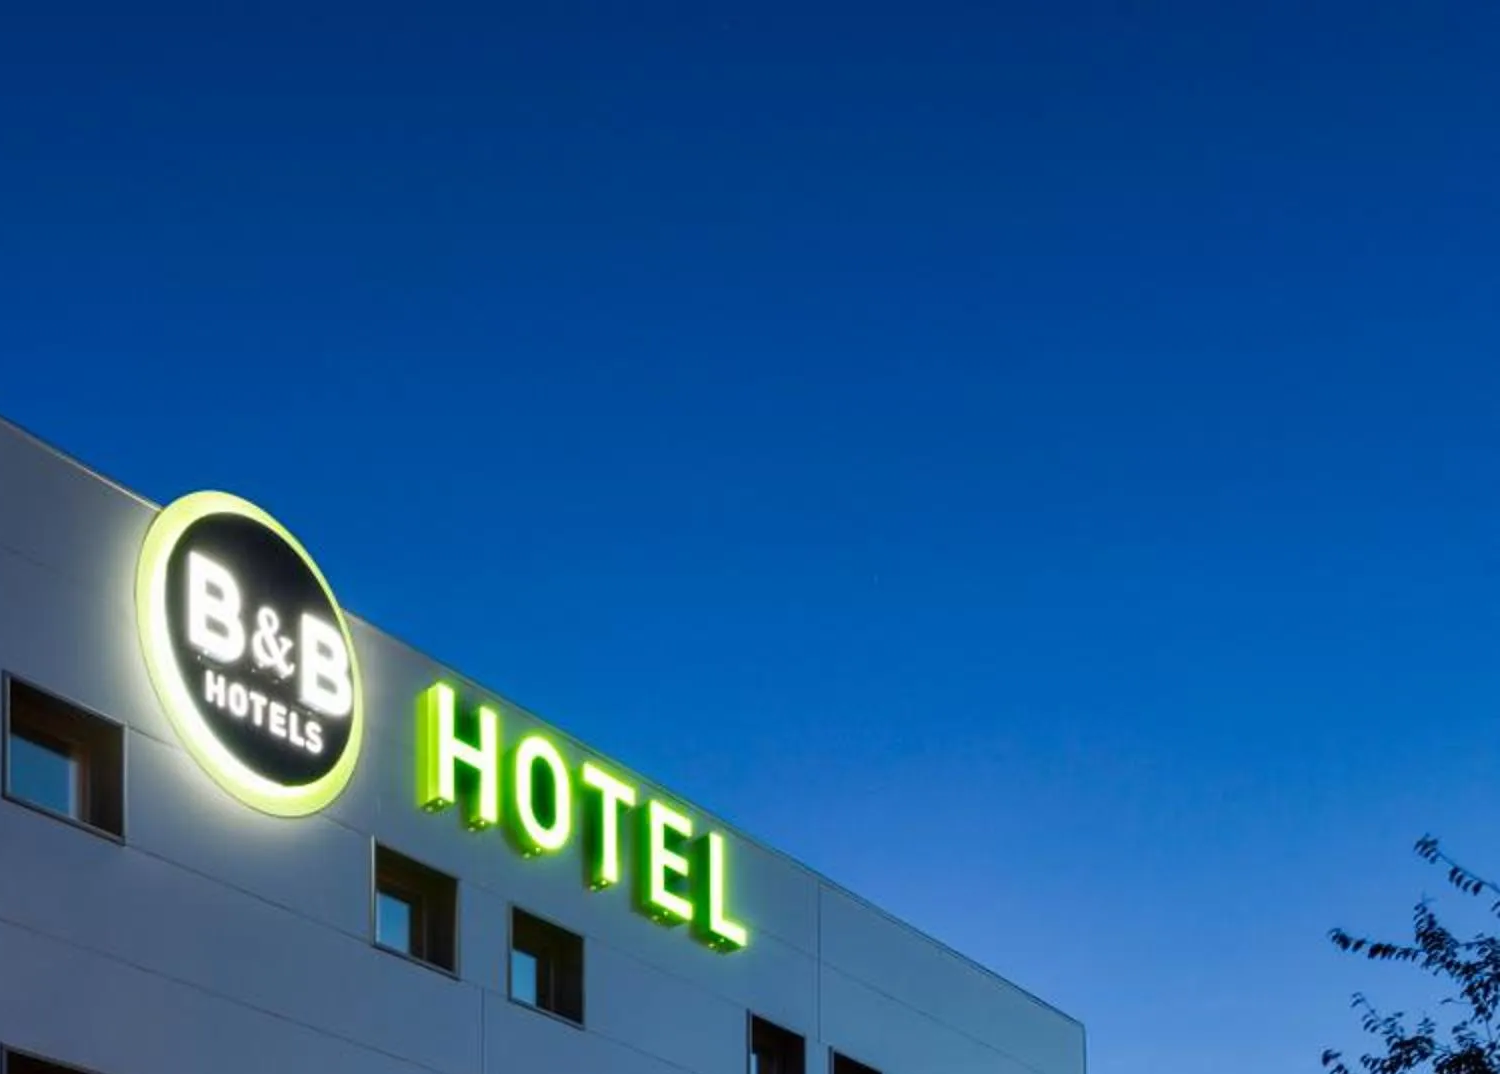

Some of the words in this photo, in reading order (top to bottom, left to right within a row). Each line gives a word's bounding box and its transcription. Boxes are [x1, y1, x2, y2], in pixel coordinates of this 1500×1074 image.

[186, 549, 354, 716] B&B
[204, 669, 325, 756] HOTELS
[418, 681, 748, 953] HOTEL
